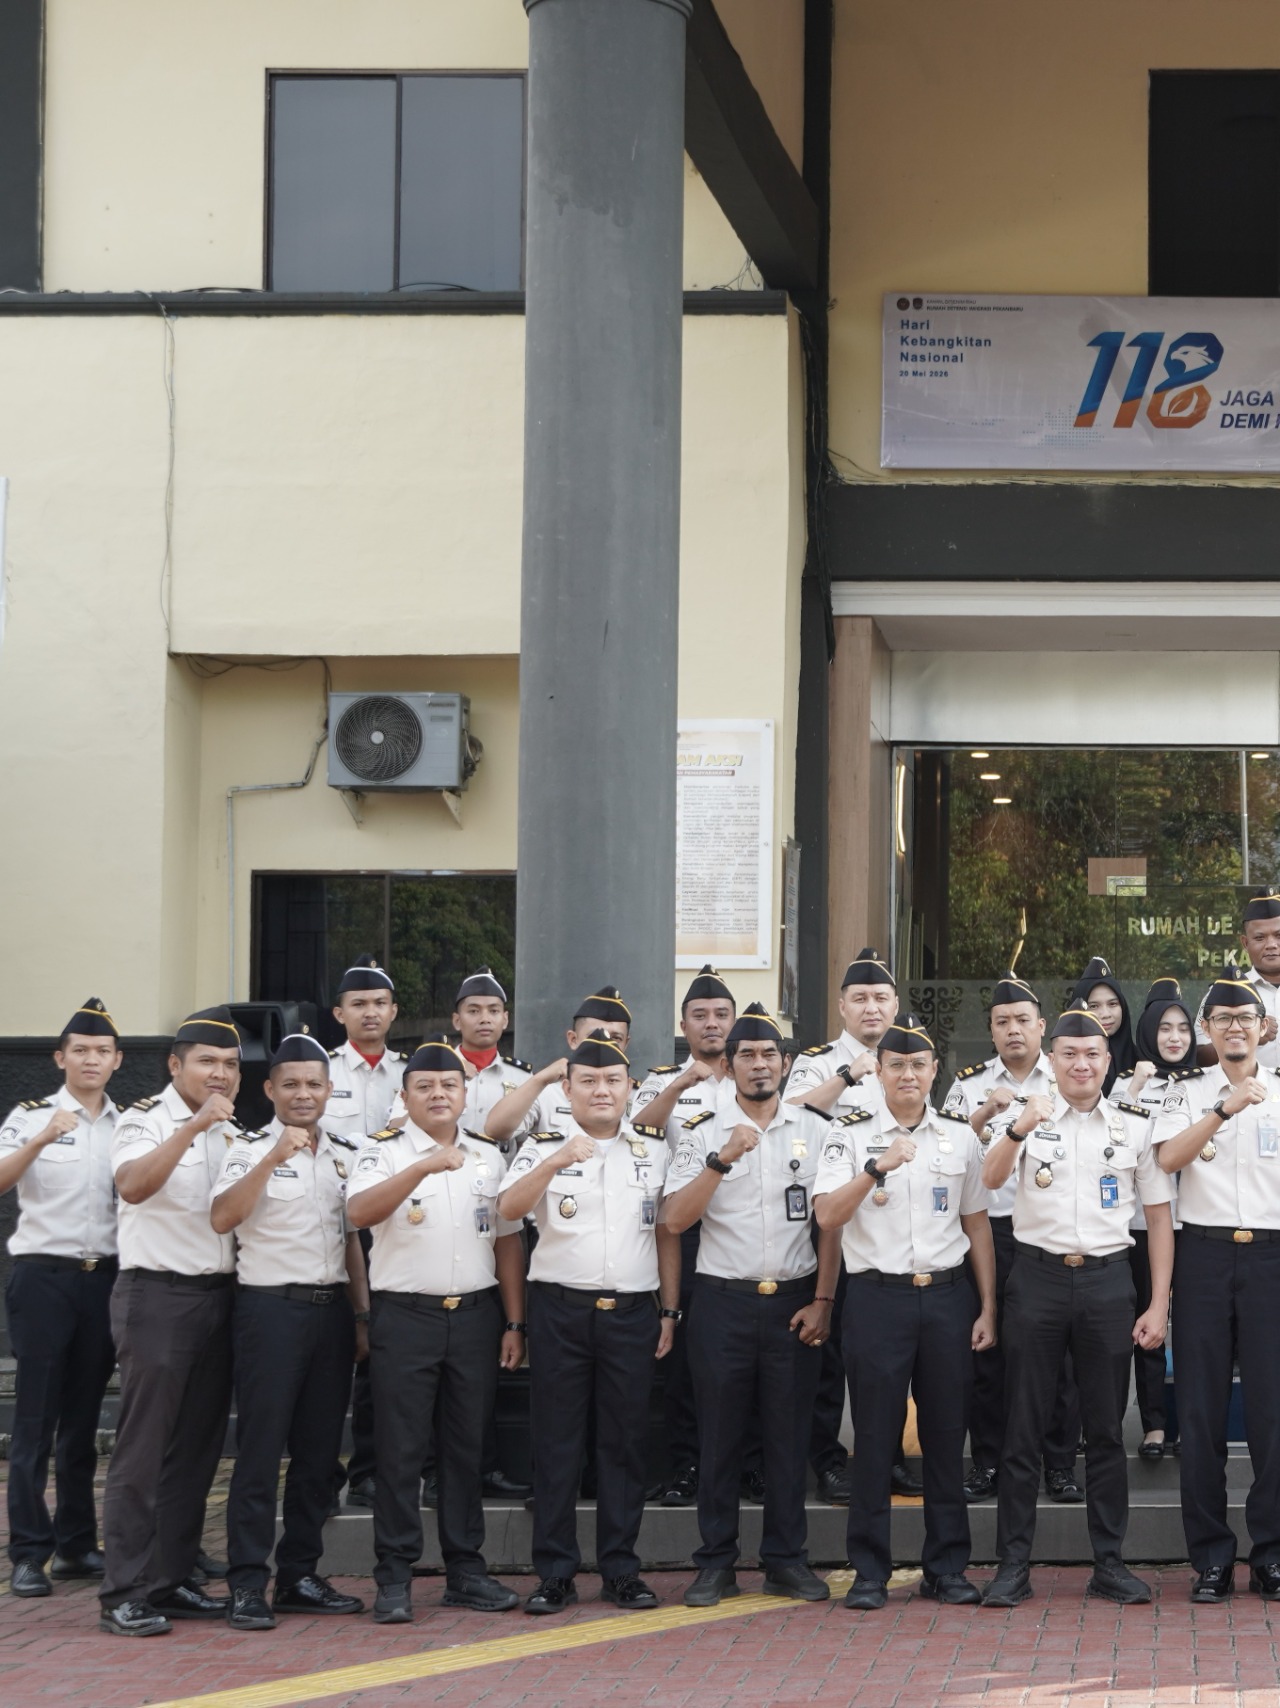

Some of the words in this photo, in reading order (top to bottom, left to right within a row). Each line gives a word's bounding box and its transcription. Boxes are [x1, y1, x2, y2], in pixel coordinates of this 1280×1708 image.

[900, 319, 930, 330] Hari
[900, 335, 992, 349] Kebangkitan
[900, 352, 964, 363] Nasional
[899, 370, 909, 378] 20
[912, 370, 926, 378] Mei
[929, 370, 949, 378] 2026
[1073, 331, 1224, 429] 118
[1219, 390, 1274, 407] JAGA
[1219, 413, 1270, 430] DEMI
[1128, 916, 1200, 935] RUMAH
